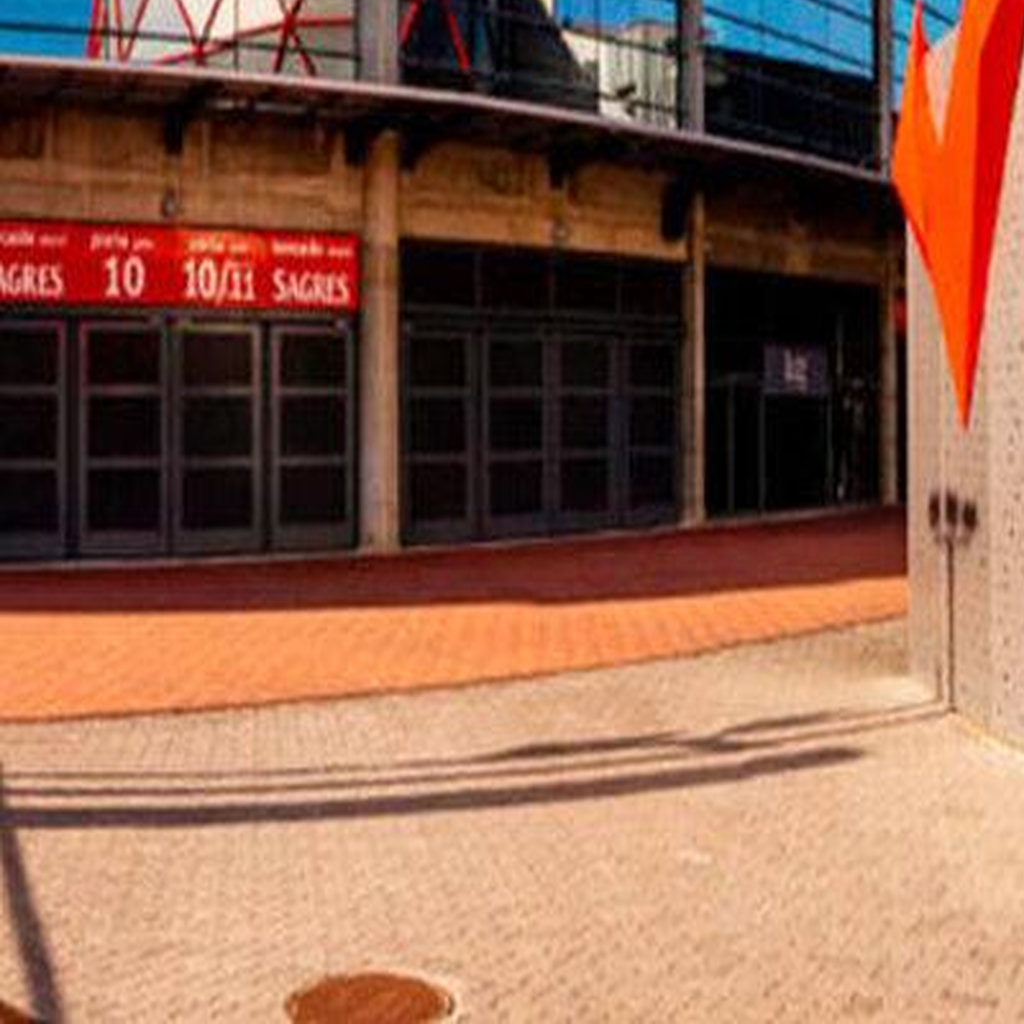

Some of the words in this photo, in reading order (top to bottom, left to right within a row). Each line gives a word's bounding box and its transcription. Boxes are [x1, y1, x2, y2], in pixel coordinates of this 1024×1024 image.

[105, 256, 146, 298] 10
[183, 258, 256, 304] 10/11
[272, 267, 349, 304] SAGRES
